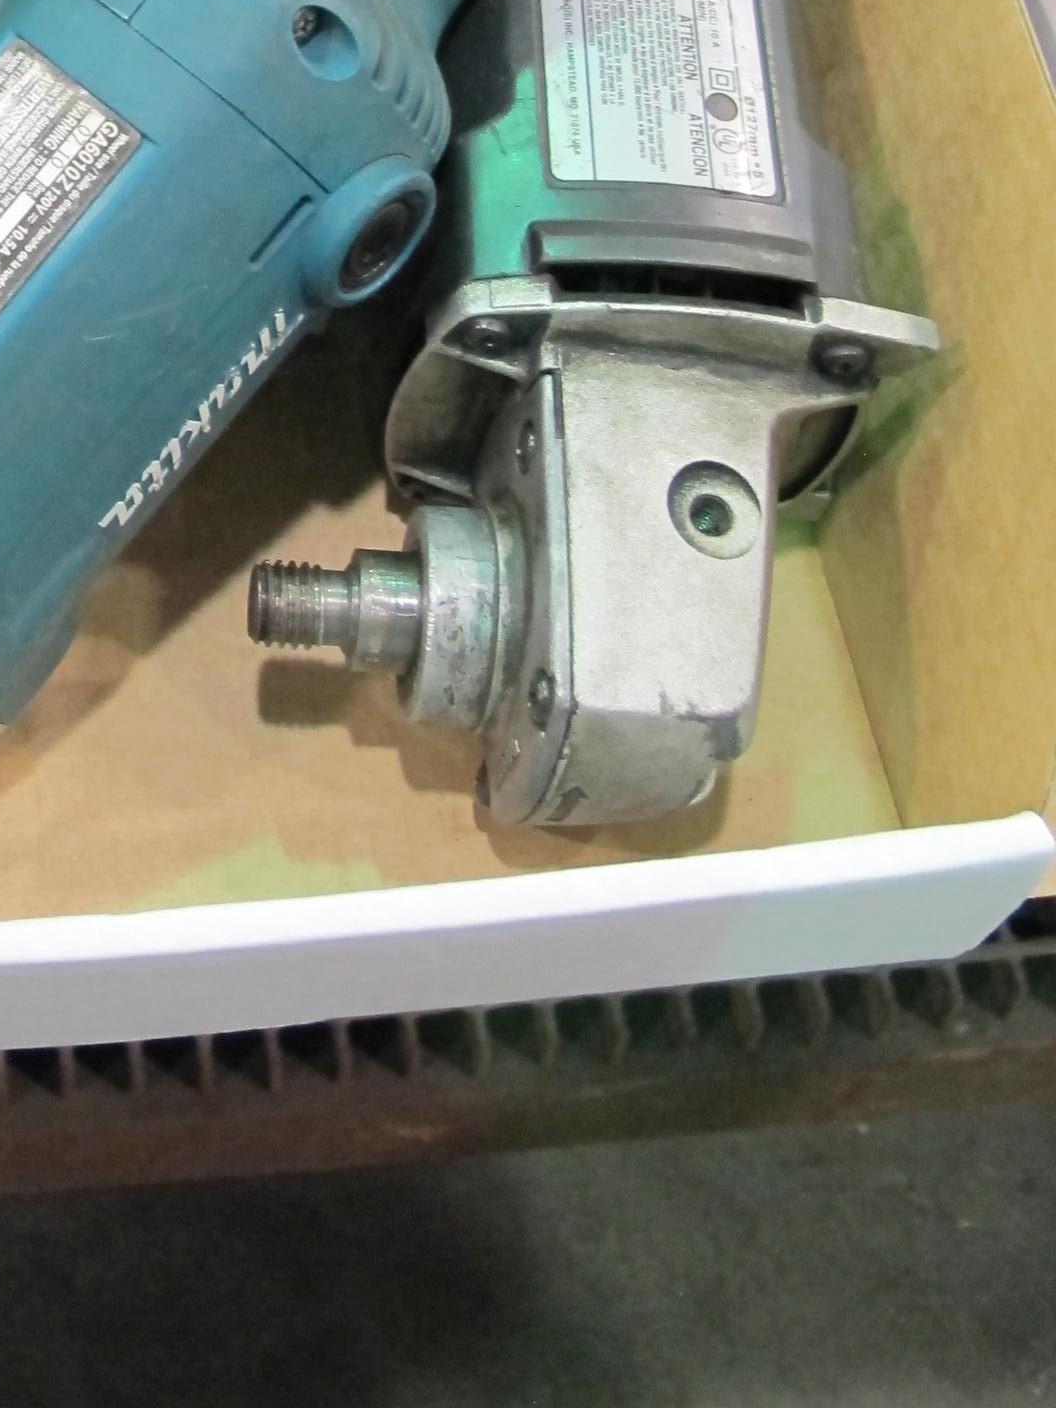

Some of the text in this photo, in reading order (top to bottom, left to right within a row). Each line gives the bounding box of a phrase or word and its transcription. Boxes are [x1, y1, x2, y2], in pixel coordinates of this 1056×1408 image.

[678, 14, 698, 81] ATTENTION
[54, 117, 121, 192] GA6010Z
[105, 130, 130, 157] Wheel
[687, 113, 708, 176] ATENCION
[31, 152, 47, 168] TO
[93, 151, 112, 171] size
[9, 162, 38, 195] REDUCE
[32, 183, 63, 216] 120V
[66, 187, 82, 203] du
[47, 197, 74, 226] disque
[9, 258, 22, 271] la
[15, 249, 30, 264] de
